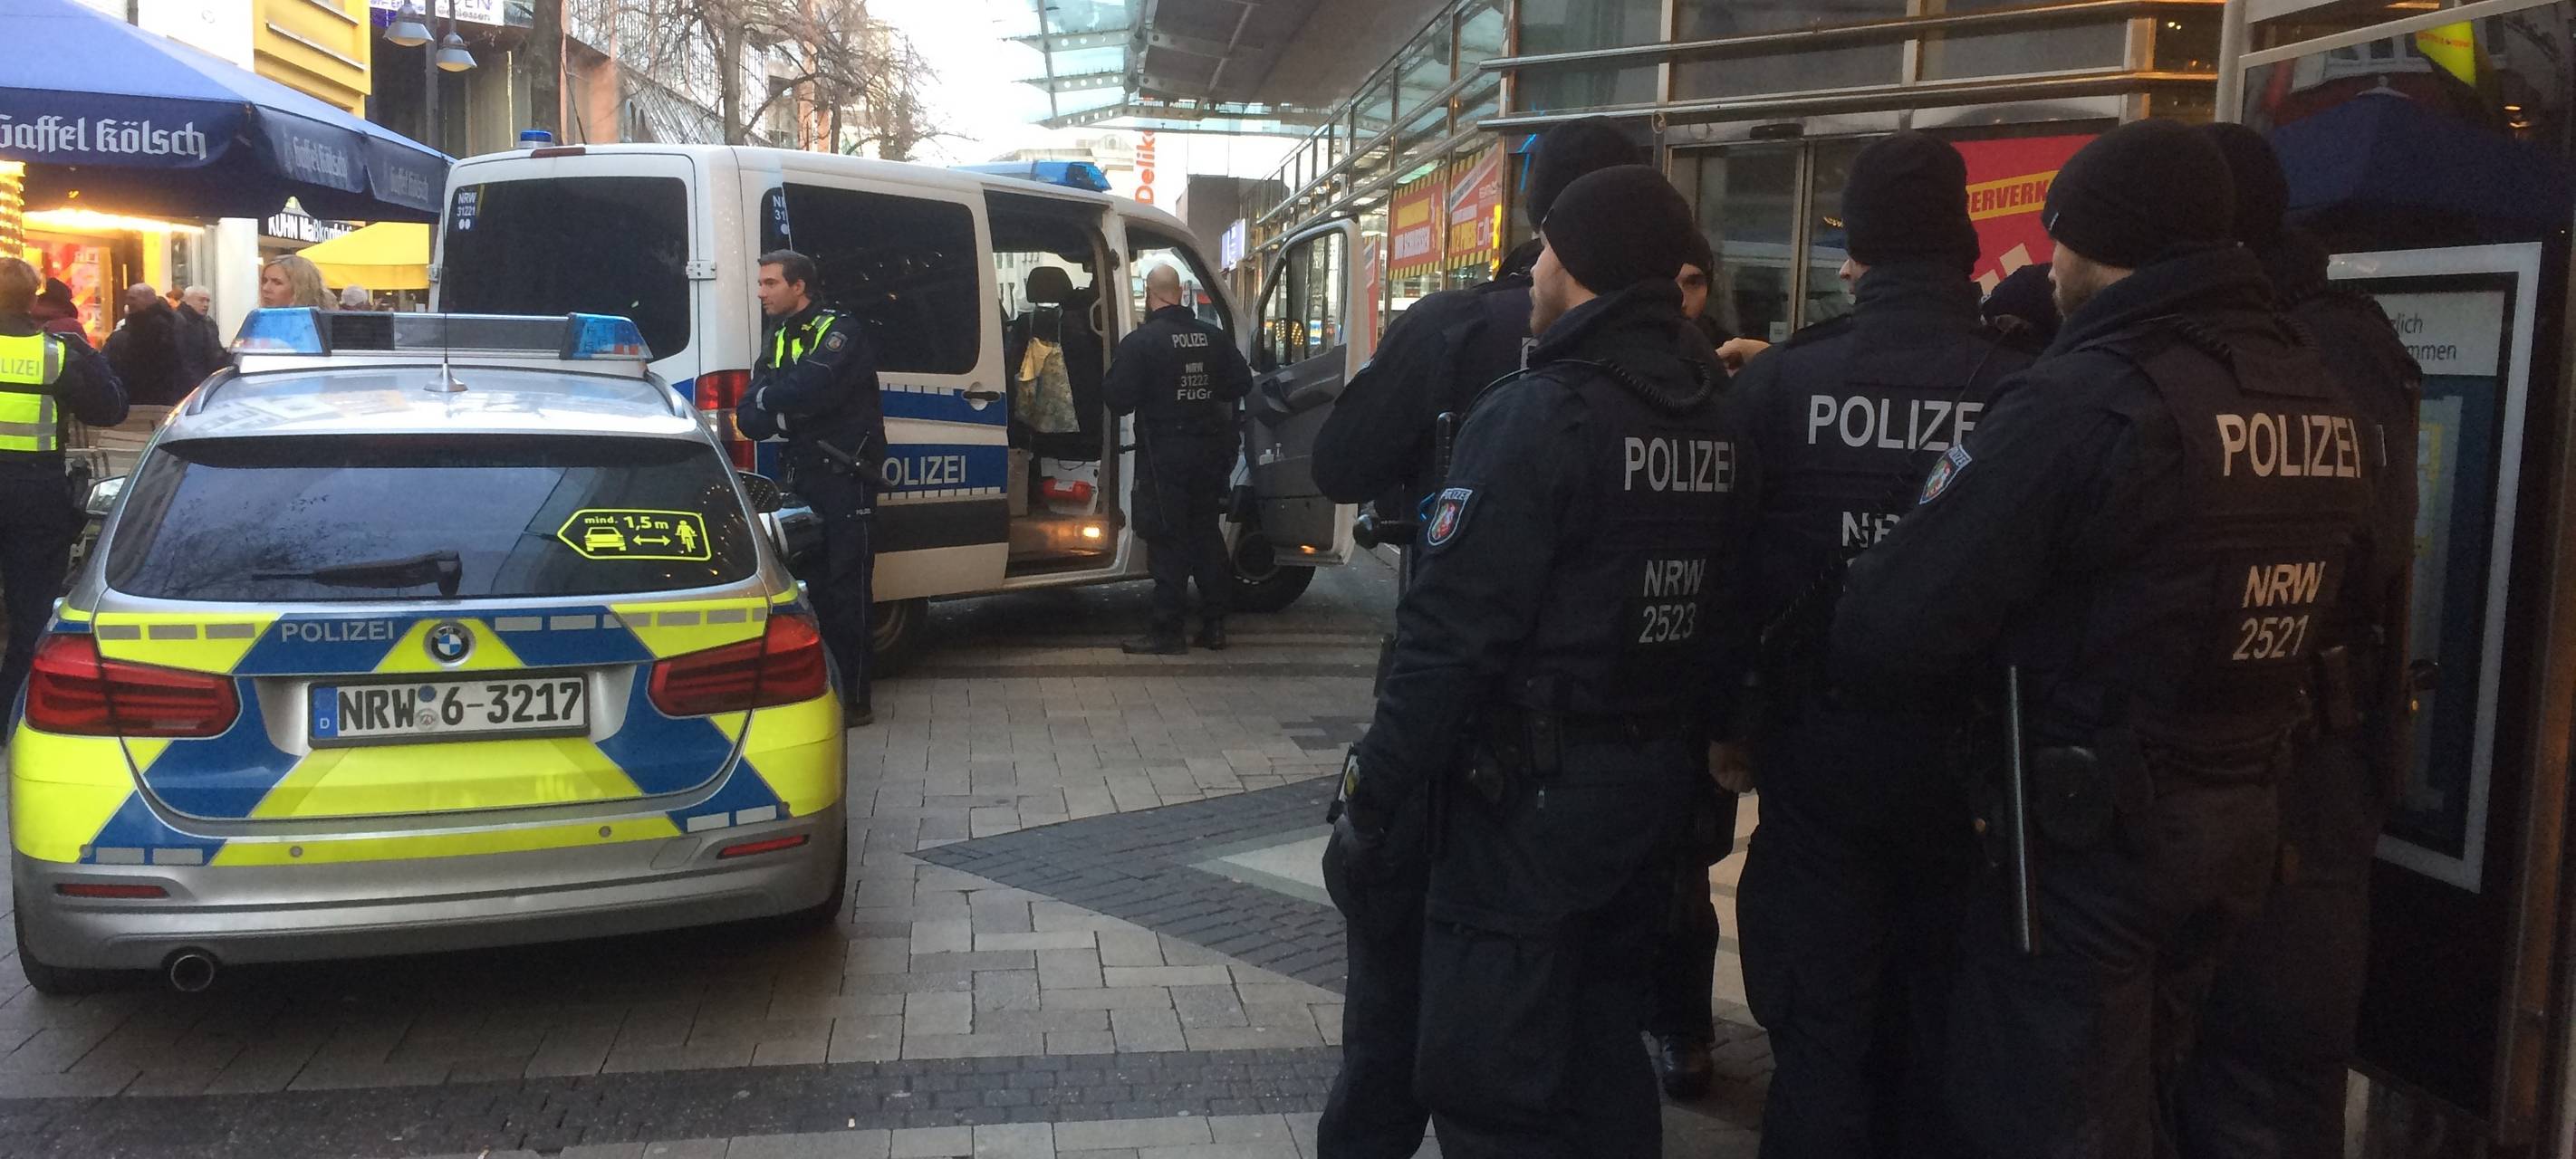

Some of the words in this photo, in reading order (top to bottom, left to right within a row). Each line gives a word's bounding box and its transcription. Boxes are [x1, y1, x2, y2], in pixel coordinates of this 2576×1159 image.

[0, 114, 91, 153] Gaffel
[96, 118, 207, 160] Kölsch
[457, 192, 477, 205] NRW
[1969, 179, 2050, 214] ERVERK
[268, 213, 298, 240] KUHN
[1171, 333, 1209, 349] POLIZEI
[2406, 344, 2456, 360] mmen
[1808, 395, 1985, 452] POLIZE
[1624, 436, 1736, 493] POLIZEI
[2216, 413, 2361, 478] POLIZEI
[881, 455, 966, 486] OLIZEI
[584, 516, 619, 524] mind.
[623, 516, 652, 531] 1,5
[655, 522, 669, 530] m
[1643, 559, 1706, 598] NRW
[2242, 561, 2326, 608] NRW
[281, 620, 394, 643] POLIZEI
[1639, 602, 1697, 643] 2523
[2232, 615, 2309, 661] 2521
[338, 688, 416, 731] NRW
[441, 682, 582, 726] 6-3217
